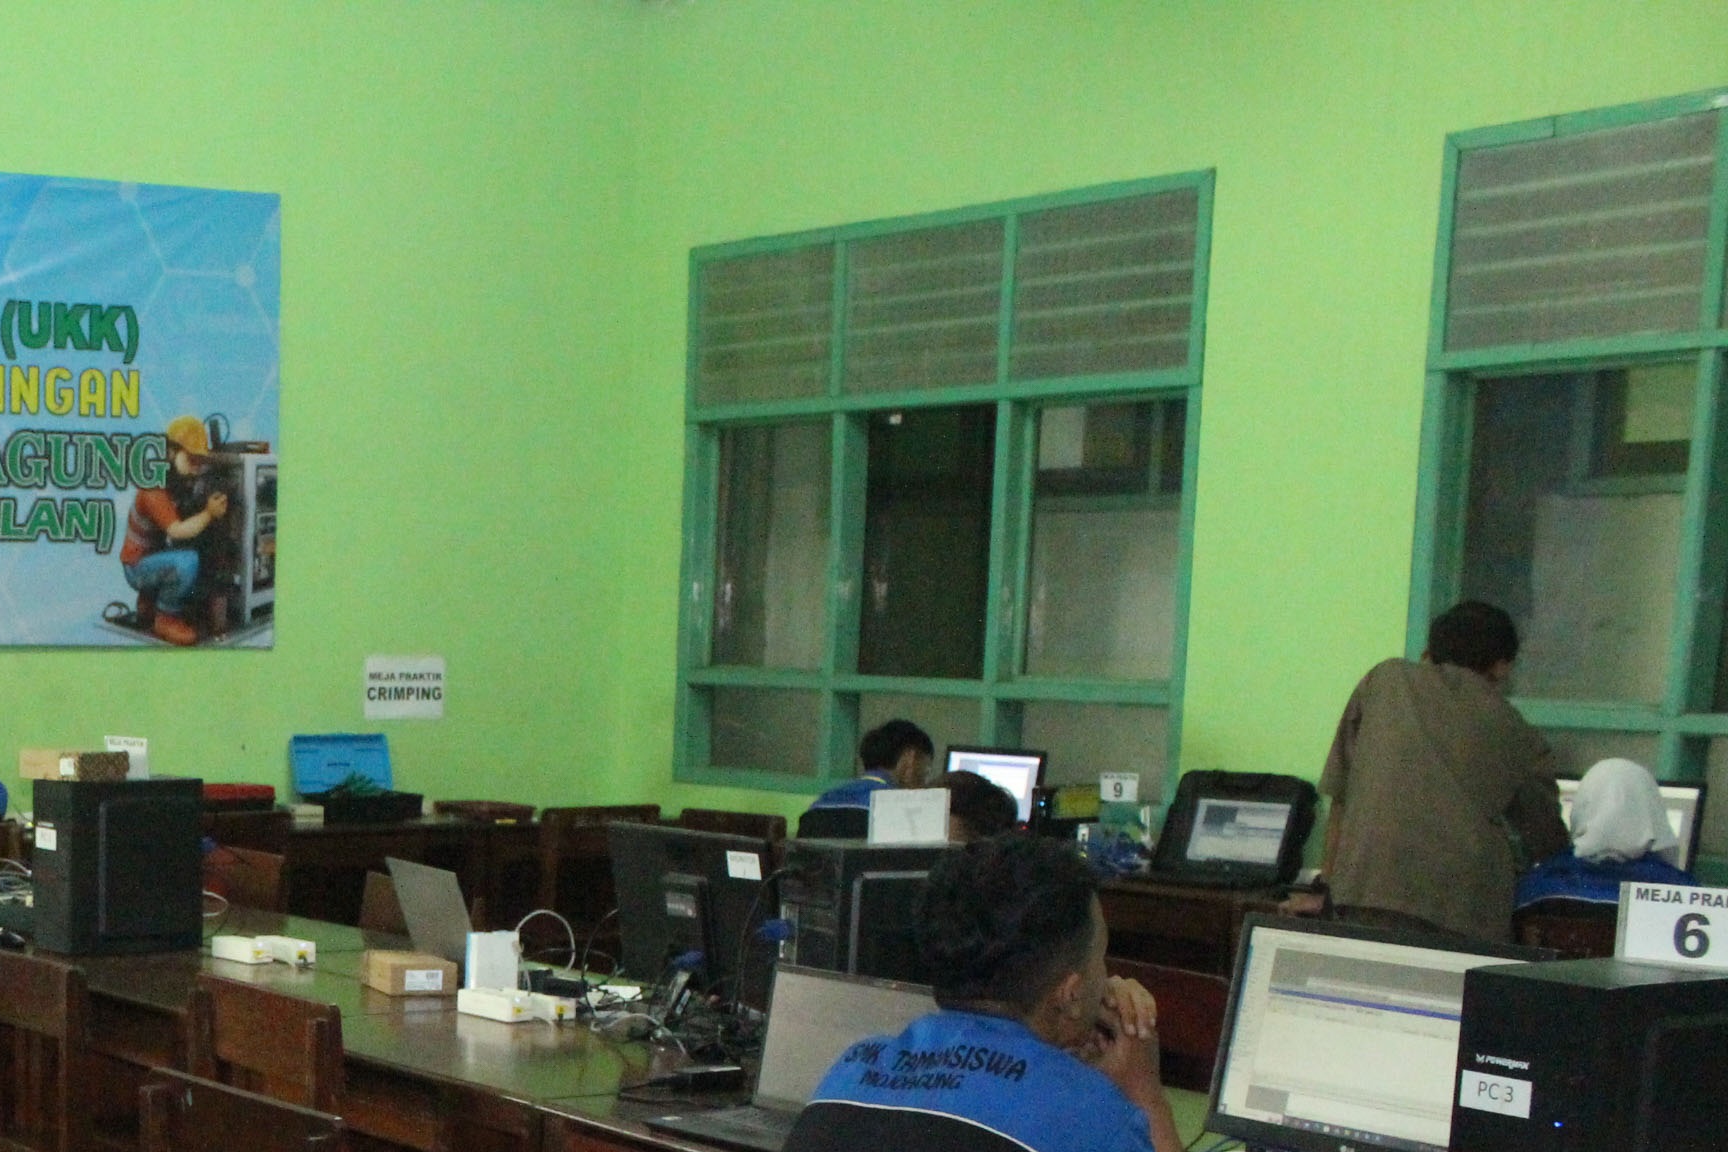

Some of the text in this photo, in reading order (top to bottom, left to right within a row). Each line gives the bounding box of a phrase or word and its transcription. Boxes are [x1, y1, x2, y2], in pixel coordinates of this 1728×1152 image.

[0, 299, 140, 364] (UKK)
[369, 672, 395, 681] MEJA
[367, 686, 442, 701] CRIMPING
[1113, 782, 1123, 798] 9
[1635, 887, 1728, 909] MEJA PRA
[1673, 912, 1711, 959] 6
[1477, 1080, 1514, 1103] PC 3
